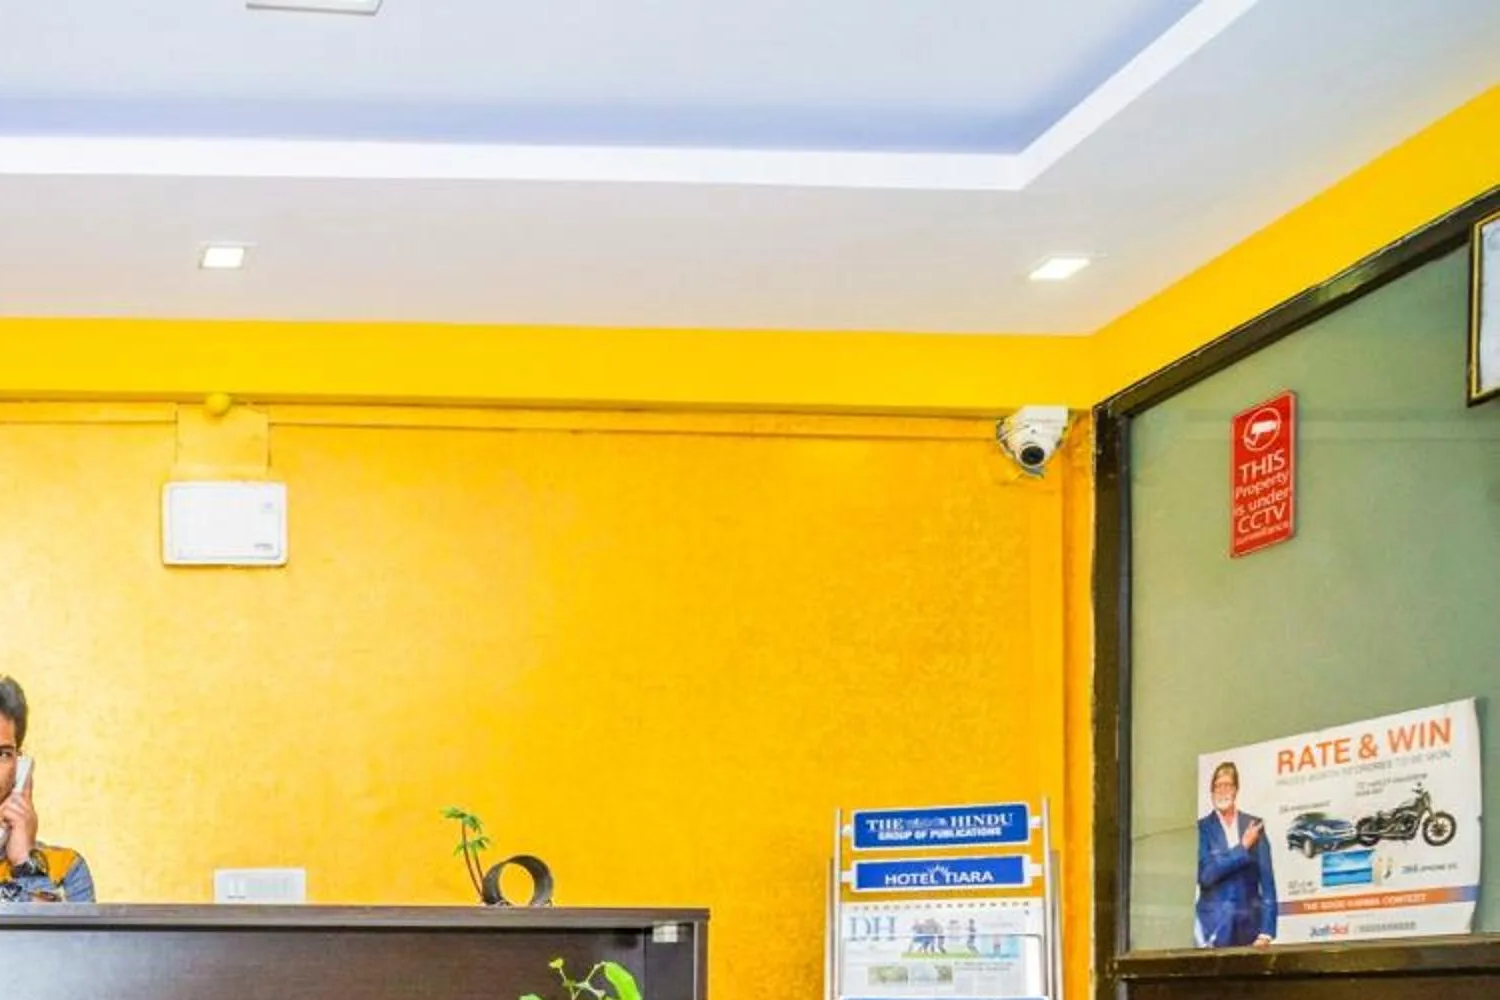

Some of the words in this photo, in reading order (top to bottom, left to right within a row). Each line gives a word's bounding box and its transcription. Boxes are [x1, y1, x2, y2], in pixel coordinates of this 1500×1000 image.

[1238, 449, 1285, 483] THIS
[1247, 488, 1289, 512] under
[1237, 502, 1287, 533] CCTV
[1277, 737, 1352, 776] RATE
[1358, 733, 1378, 760] &
[1387, 717, 1452, 751] WIN
[866, 818, 904, 832] THE
[950, 812, 1014, 827] HINDU
[877, 830, 912, 841] GROUP
[914, 830, 928, 840] OF
[929, 827, 1002, 839] PUBLICATIONS
[884, 871, 936, 886] HOTEL
[942, 870, 994, 884] TIARA
[849, 915, 899, 942] DH
